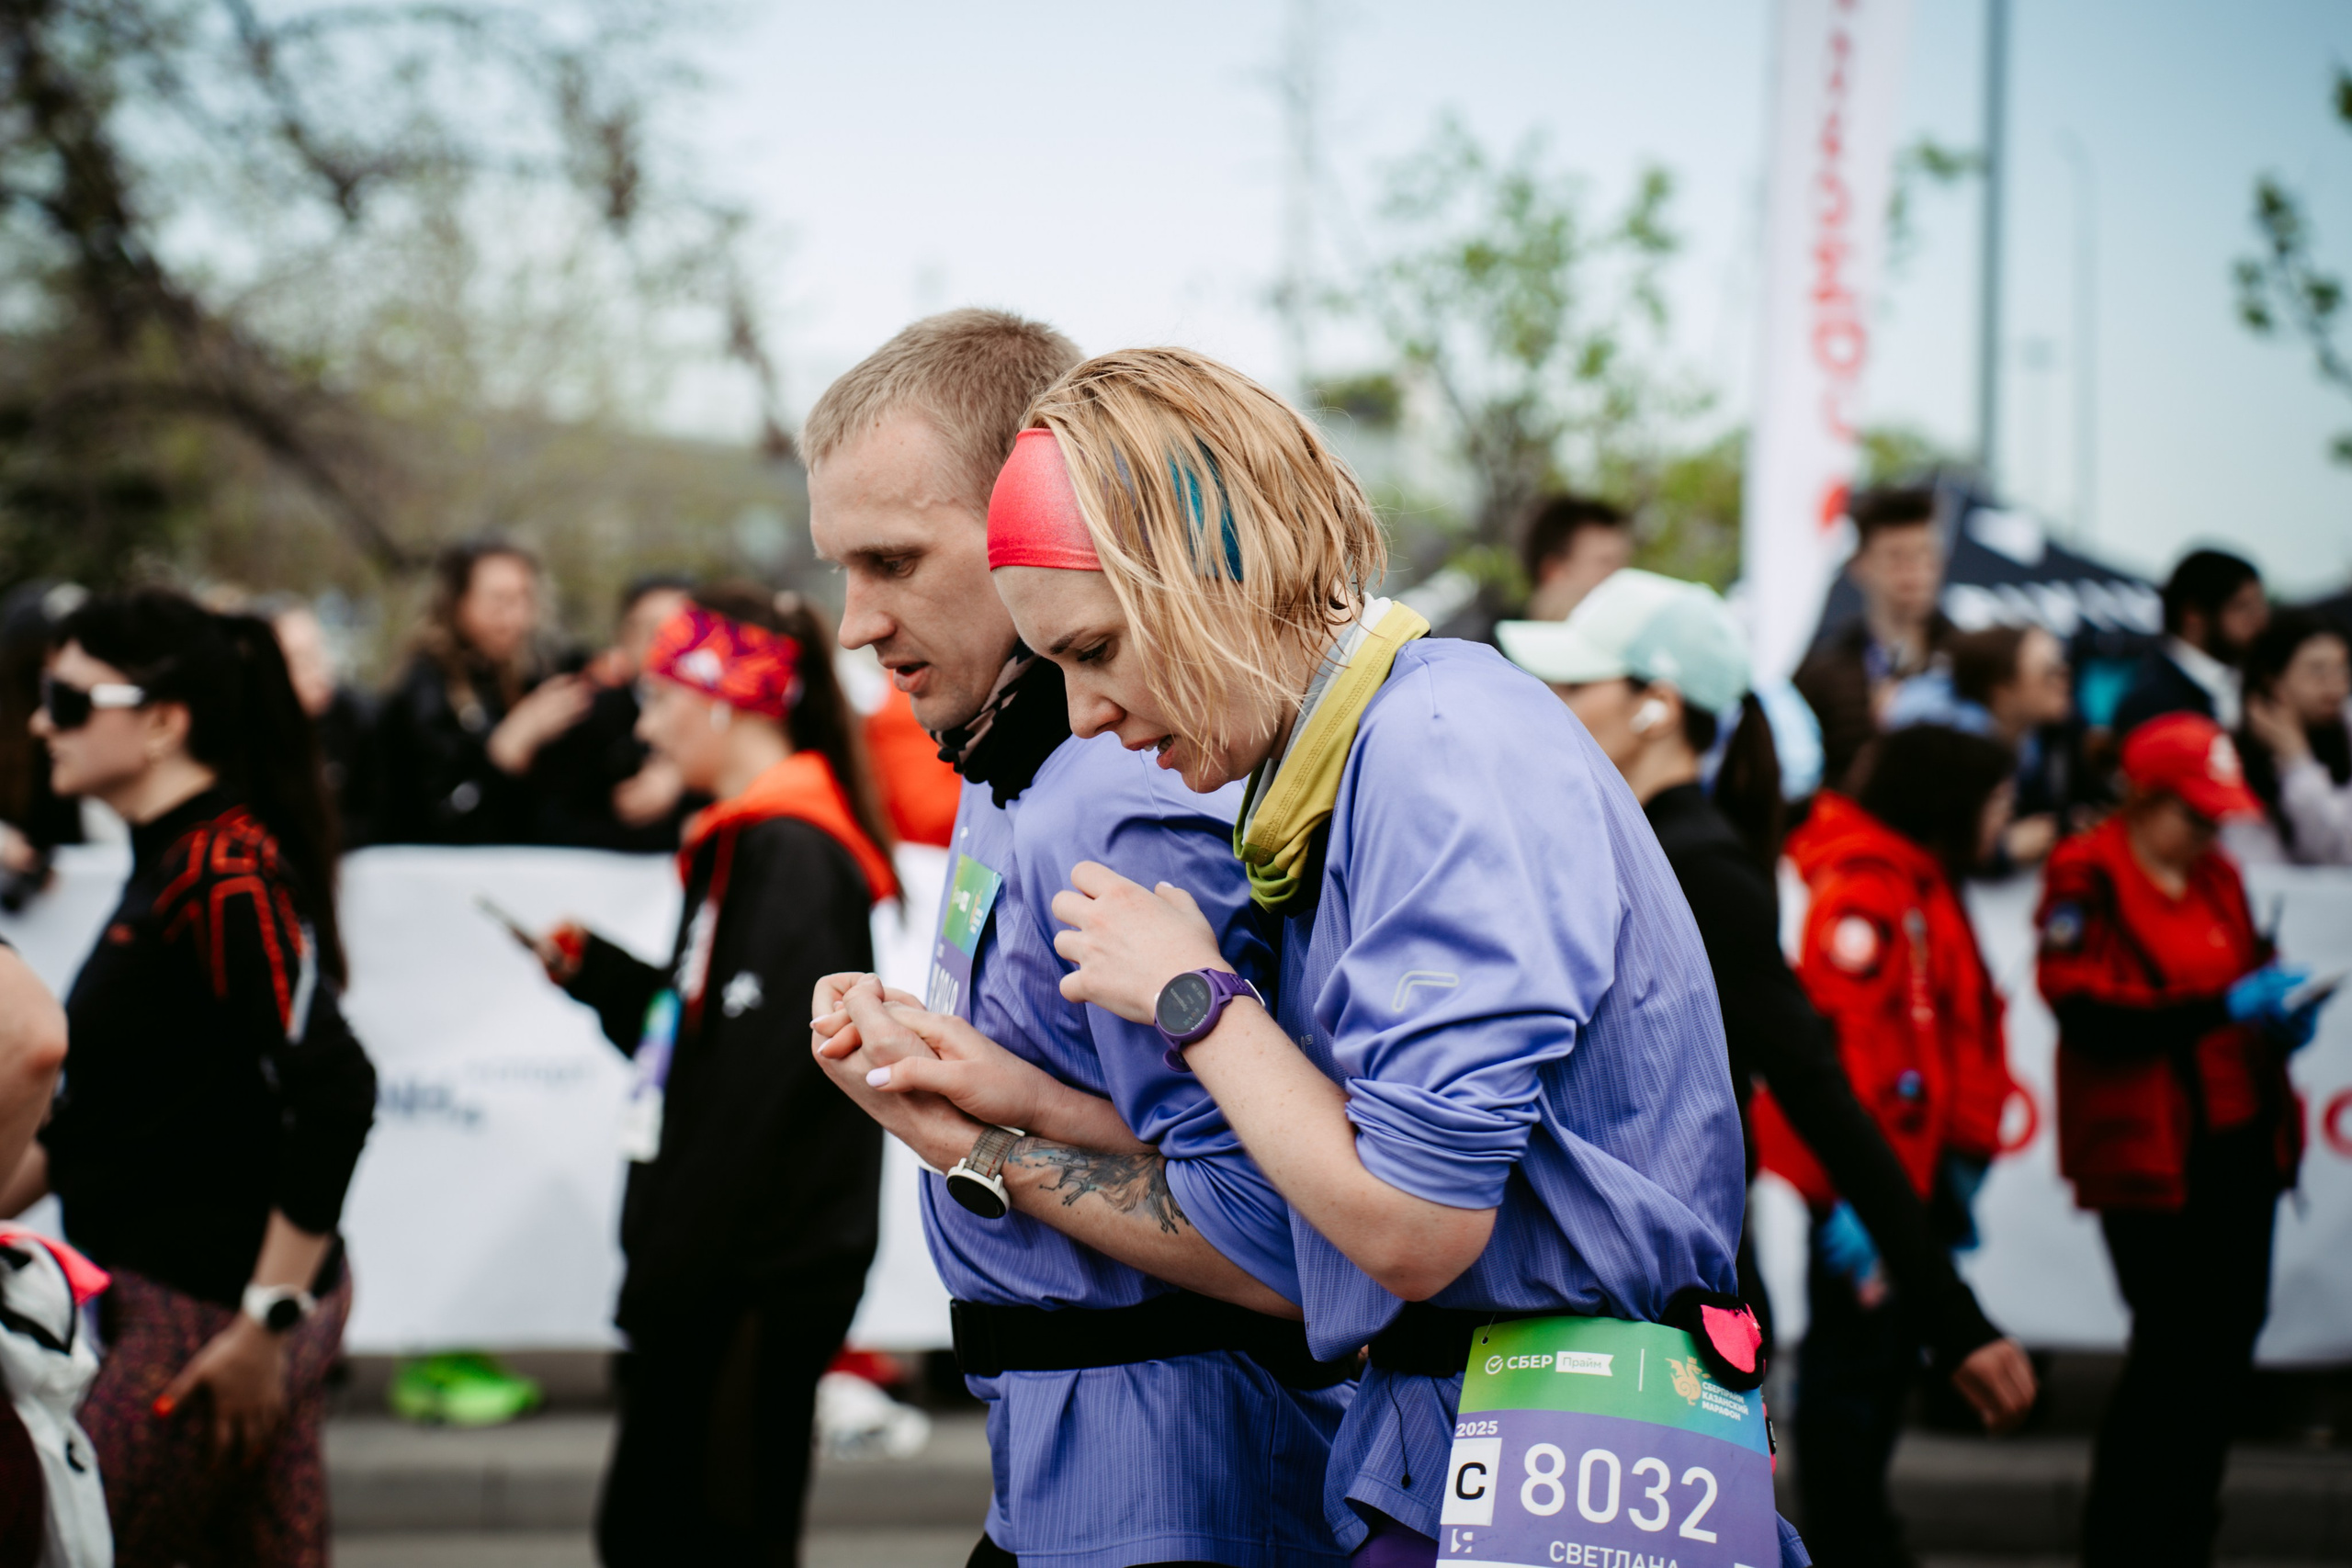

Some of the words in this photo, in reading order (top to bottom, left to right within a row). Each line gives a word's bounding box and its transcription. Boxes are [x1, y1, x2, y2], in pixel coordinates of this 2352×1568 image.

[1507, 1354, 1554, 1370] СБЕР
[1562, 1356, 1602, 1369] Прайм
[1702, 1390, 1749, 1416] КАЗАНСКИЙ
[1702, 1400, 1741, 1421] МАРАФОН
[1455, 1420, 1498, 1438] 2025
[1520, 1442, 1719, 1545] 8032
